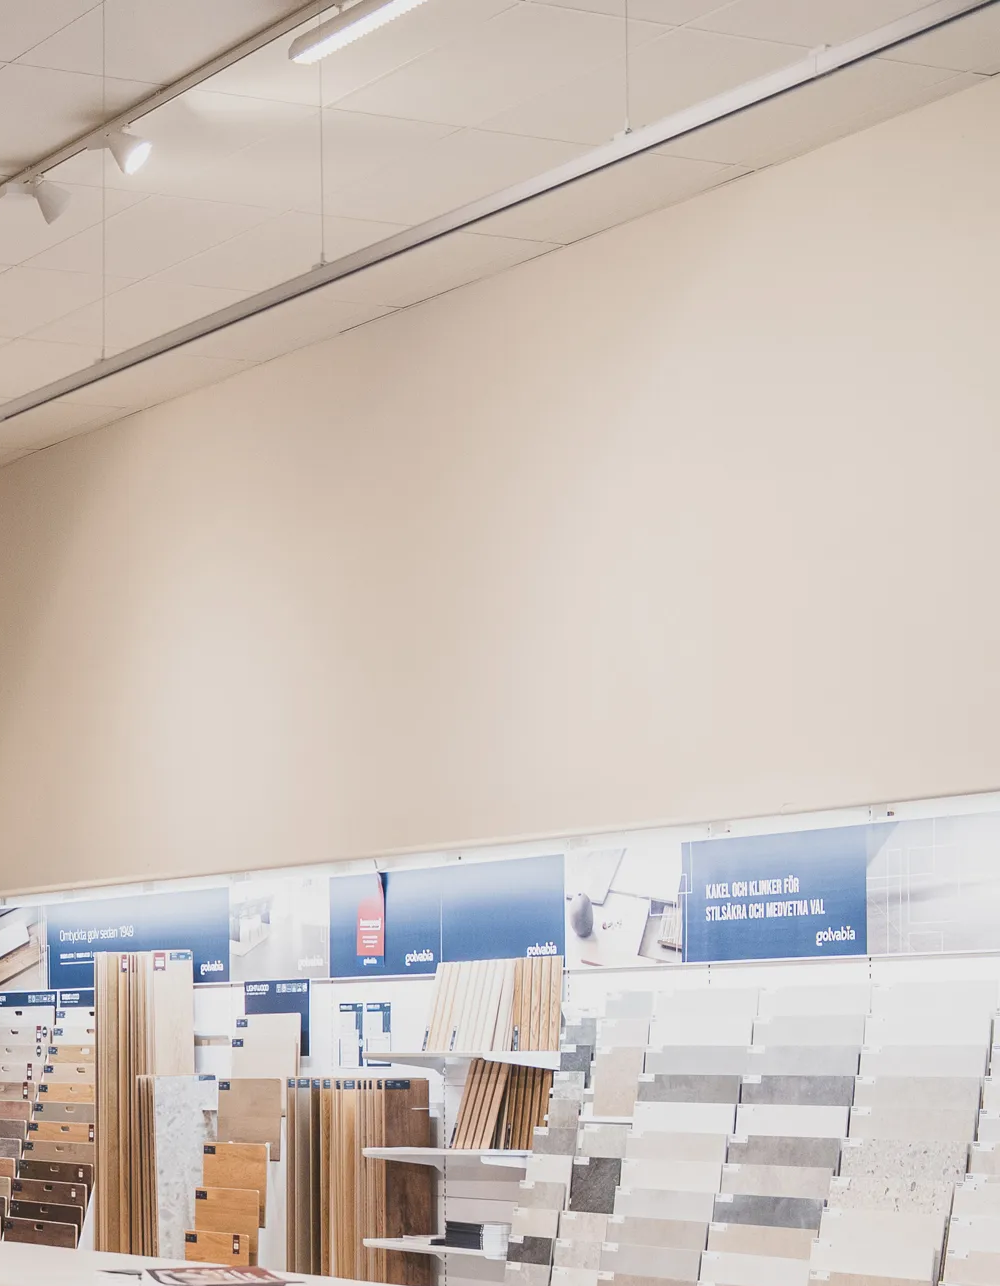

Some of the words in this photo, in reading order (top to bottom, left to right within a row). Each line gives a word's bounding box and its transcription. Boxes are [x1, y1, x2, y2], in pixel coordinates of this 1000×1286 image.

[706, 883, 731, 899] KAKEL
[732, 881, 748, 898] OCH
[750, 878, 782, 896] KLINKER
[784, 874, 800, 894] FÖR
[705, 902, 747, 921] STILSÄKRA
[749, 902, 764, 919] OCH
[766, 899, 808, 918] MEDVETNA
[810, 899, 825, 915] VAL
[60, 929, 87, 944] Omtyckta
[87, 928, 100, 943] golv
[100, 927, 118, 940] sedan
[119, 925, 134, 938] 1949
[815, 925, 856, 946] golvabia
[200, 960, 224, 975] golvabia
[405, 949, 434, 966] golvabia
